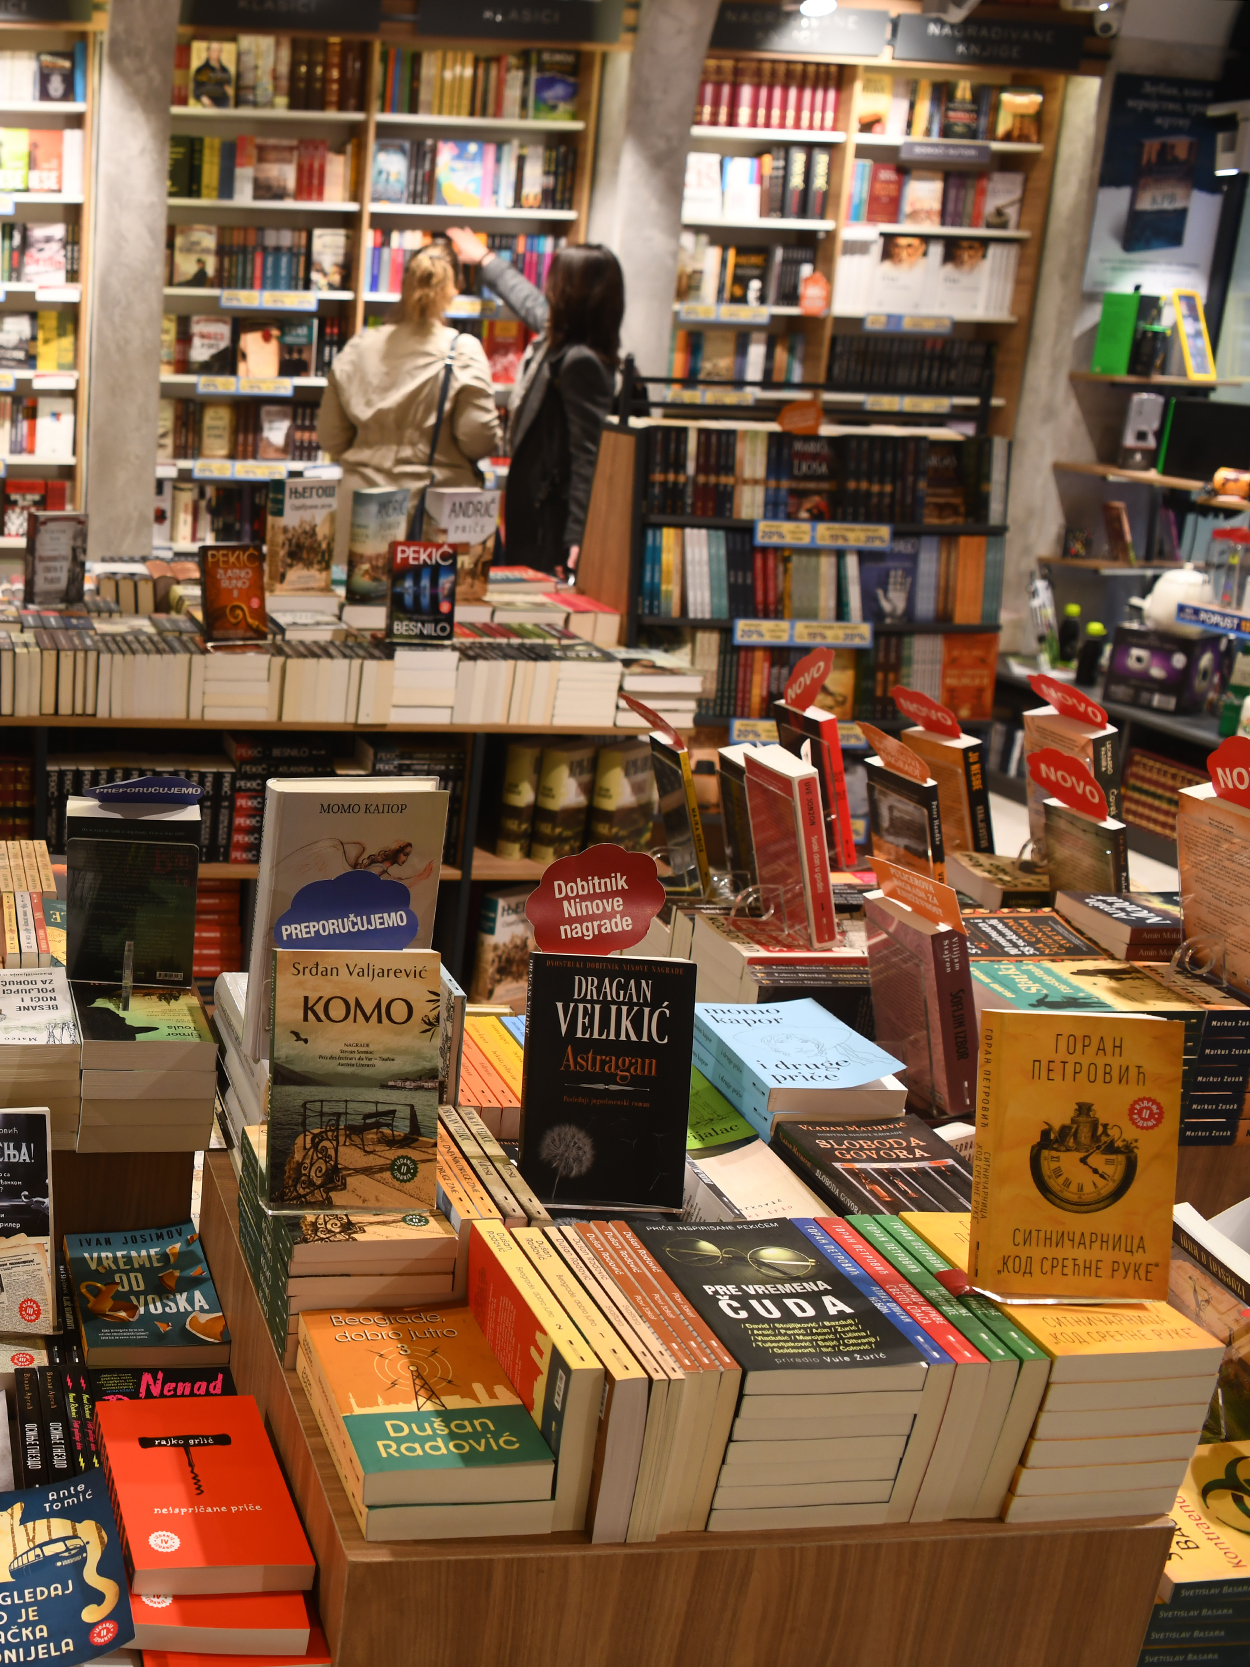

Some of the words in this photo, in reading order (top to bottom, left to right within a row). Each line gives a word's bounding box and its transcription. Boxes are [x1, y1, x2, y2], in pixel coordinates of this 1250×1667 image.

[207, 548, 258, 568] PEKIĆ
[396, 544, 453, 566] PEKIĆ
[393, 622, 450, 636] BESNILO
[786, 661, 825, 703] NOVO
[1041, 683, 1102, 722] NOVO
[95, 787, 201, 795] PREPORUČUJEMO
[1039, 763, 1099, 803] NOVO
[319, 804, 360, 814] МОМО
[364, 803, 407, 814] КАПОР
[554, 873, 628, 899] Dobitnik
[563, 897, 624, 918] Ninove
[282, 910, 407, 940] PREPORUČUJEMO
[560, 916, 632, 940] nagrade
[292, 962, 339, 977] Srđan
[346, 963, 427, 982] Valjarević
[2, 986, 56, 996] POLJUPCI
[573, 976, 652, 1003] DRAGAN
[15, 1003, 59, 1012] BESANE
[302, 996, 414, 1025] KOMO
[703, 1007, 780, 1016] momo
[556, 1001, 670, 1044] VELIKIĆ
[1055, 1033, 1123, 1058] ГОРАН
[560, 1045, 657, 1084] Astragan
[1032, 1060, 1146, 1086] ПЕТРОВИЋ
[798, 1124, 845, 1132] VLADAN
[846, 1121, 907, 1131] MATIJEVIĆ
[816, 1138, 926, 1148] SLOBODA
[835, 1148, 931, 1159] GOVORA
[79, 1235, 113, 1247] IVAN
[123, 1227, 184, 1246] JOSIMOV
[647, 1225, 676, 1233] PRIČE
[677, 1223, 727, 1233] INSPIRISANE
[729, 1220, 779, 1231] PEKIĆEM
[1012, 1228, 1146, 1256] СИТНИЧАРНИЦА
[83, 1248, 165, 1270] VREME
[115, 1272, 146, 1293] OD
[703, 1284, 742, 1295] PRE
[741, 1281, 832, 1295] VREMENA
[131, 1291, 210, 1316] VOSKA
[718, 1294, 854, 1319] ČUDA
[329, 1312, 446, 1328] Beograde,
[334, 1327, 404, 1343] dobro
[407, 1325, 458, 1342] jutro
[139, 1372, 223, 1398] Nenad
[385, 1416, 496, 1438] Dušan
[154, 1437, 185, 1447] rajko
[188, 1436, 214, 1446] grlić
[376, 1432, 521, 1459] Radović
[44, 1488, 94, 1513] Tomić
[48, 1482, 86, 1502] Ante
[153, 1506, 228, 1516] neispričane
[231, 1503, 262, 1514] priče
[17, 1607, 39, 1622] JE
